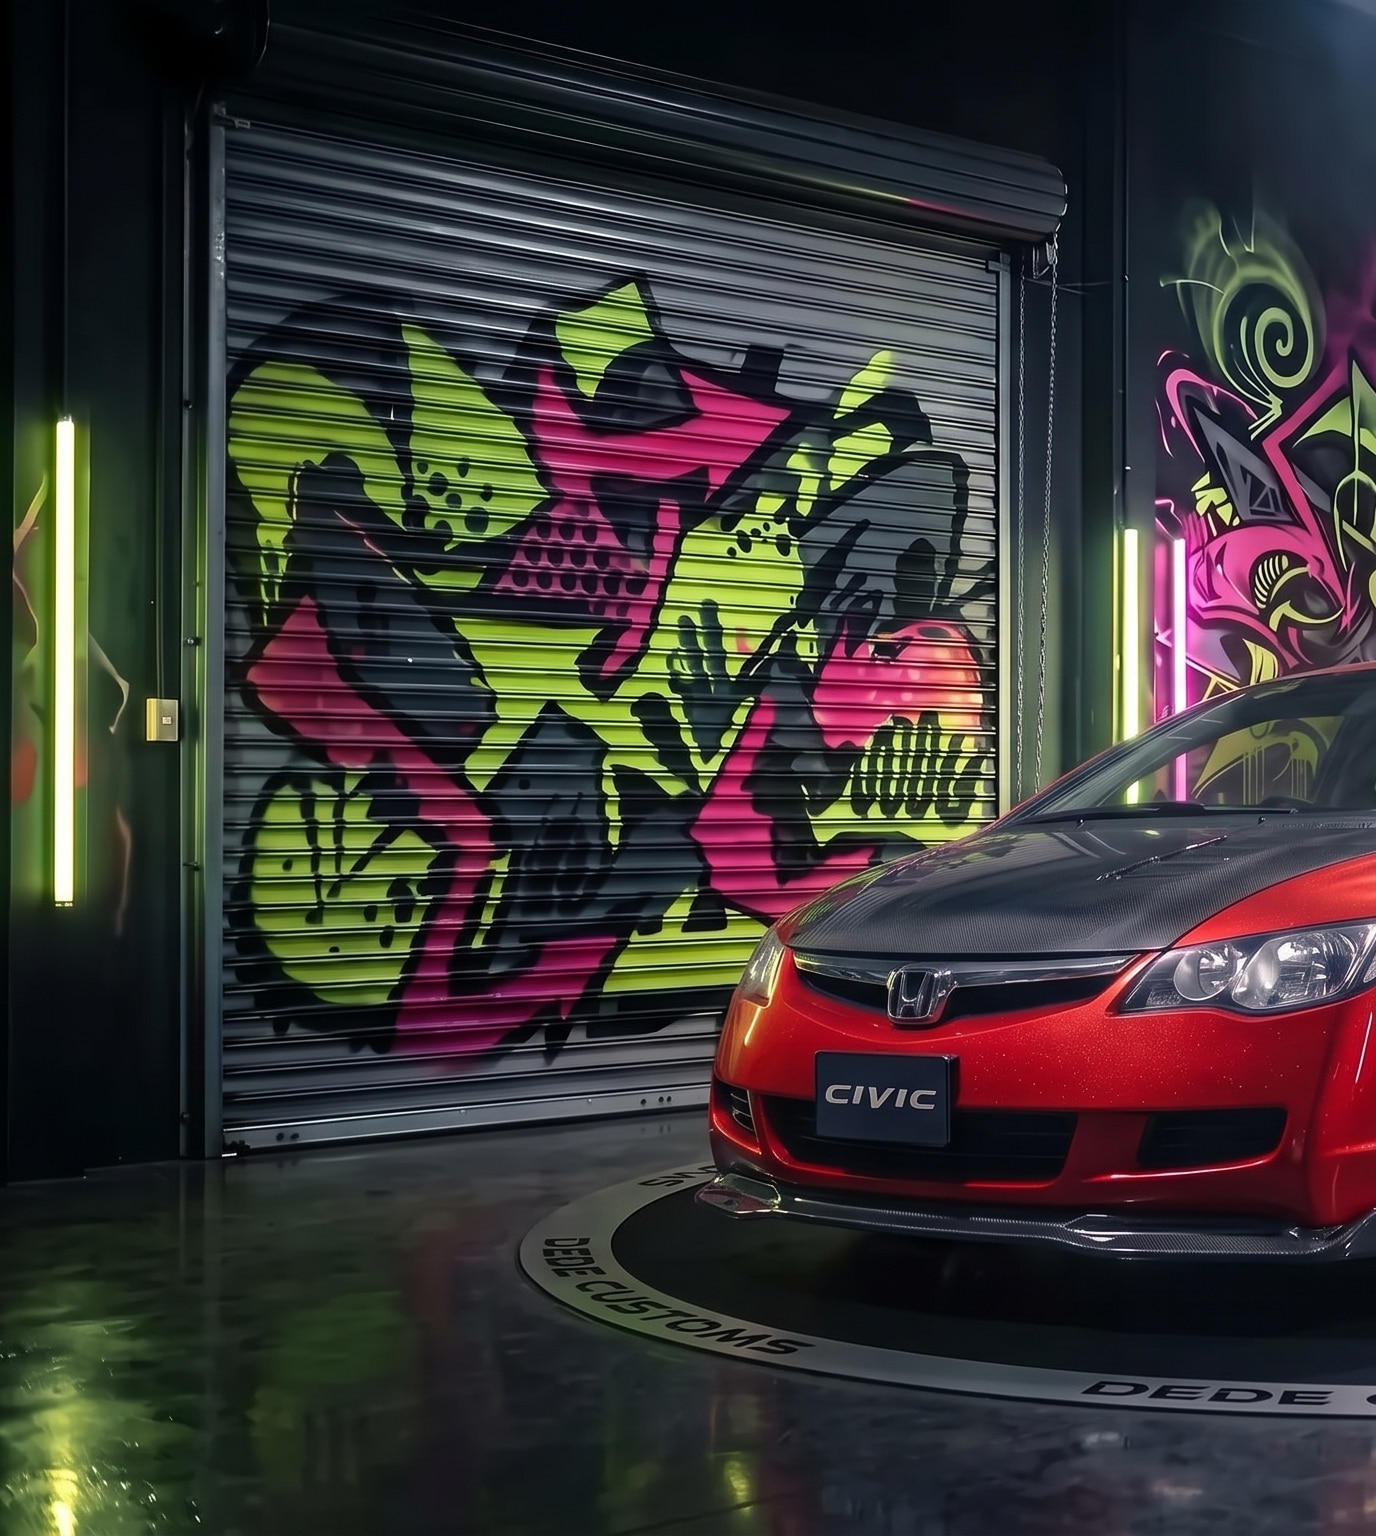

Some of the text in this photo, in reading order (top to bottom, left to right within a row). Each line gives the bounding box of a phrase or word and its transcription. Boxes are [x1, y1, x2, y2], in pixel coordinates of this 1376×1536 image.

[825, 1084, 937, 1110] CIVIC
[542, 1237, 816, 1355] DEDE CUSTOMS
[1081, 1380, 1336, 1406] DEDE
